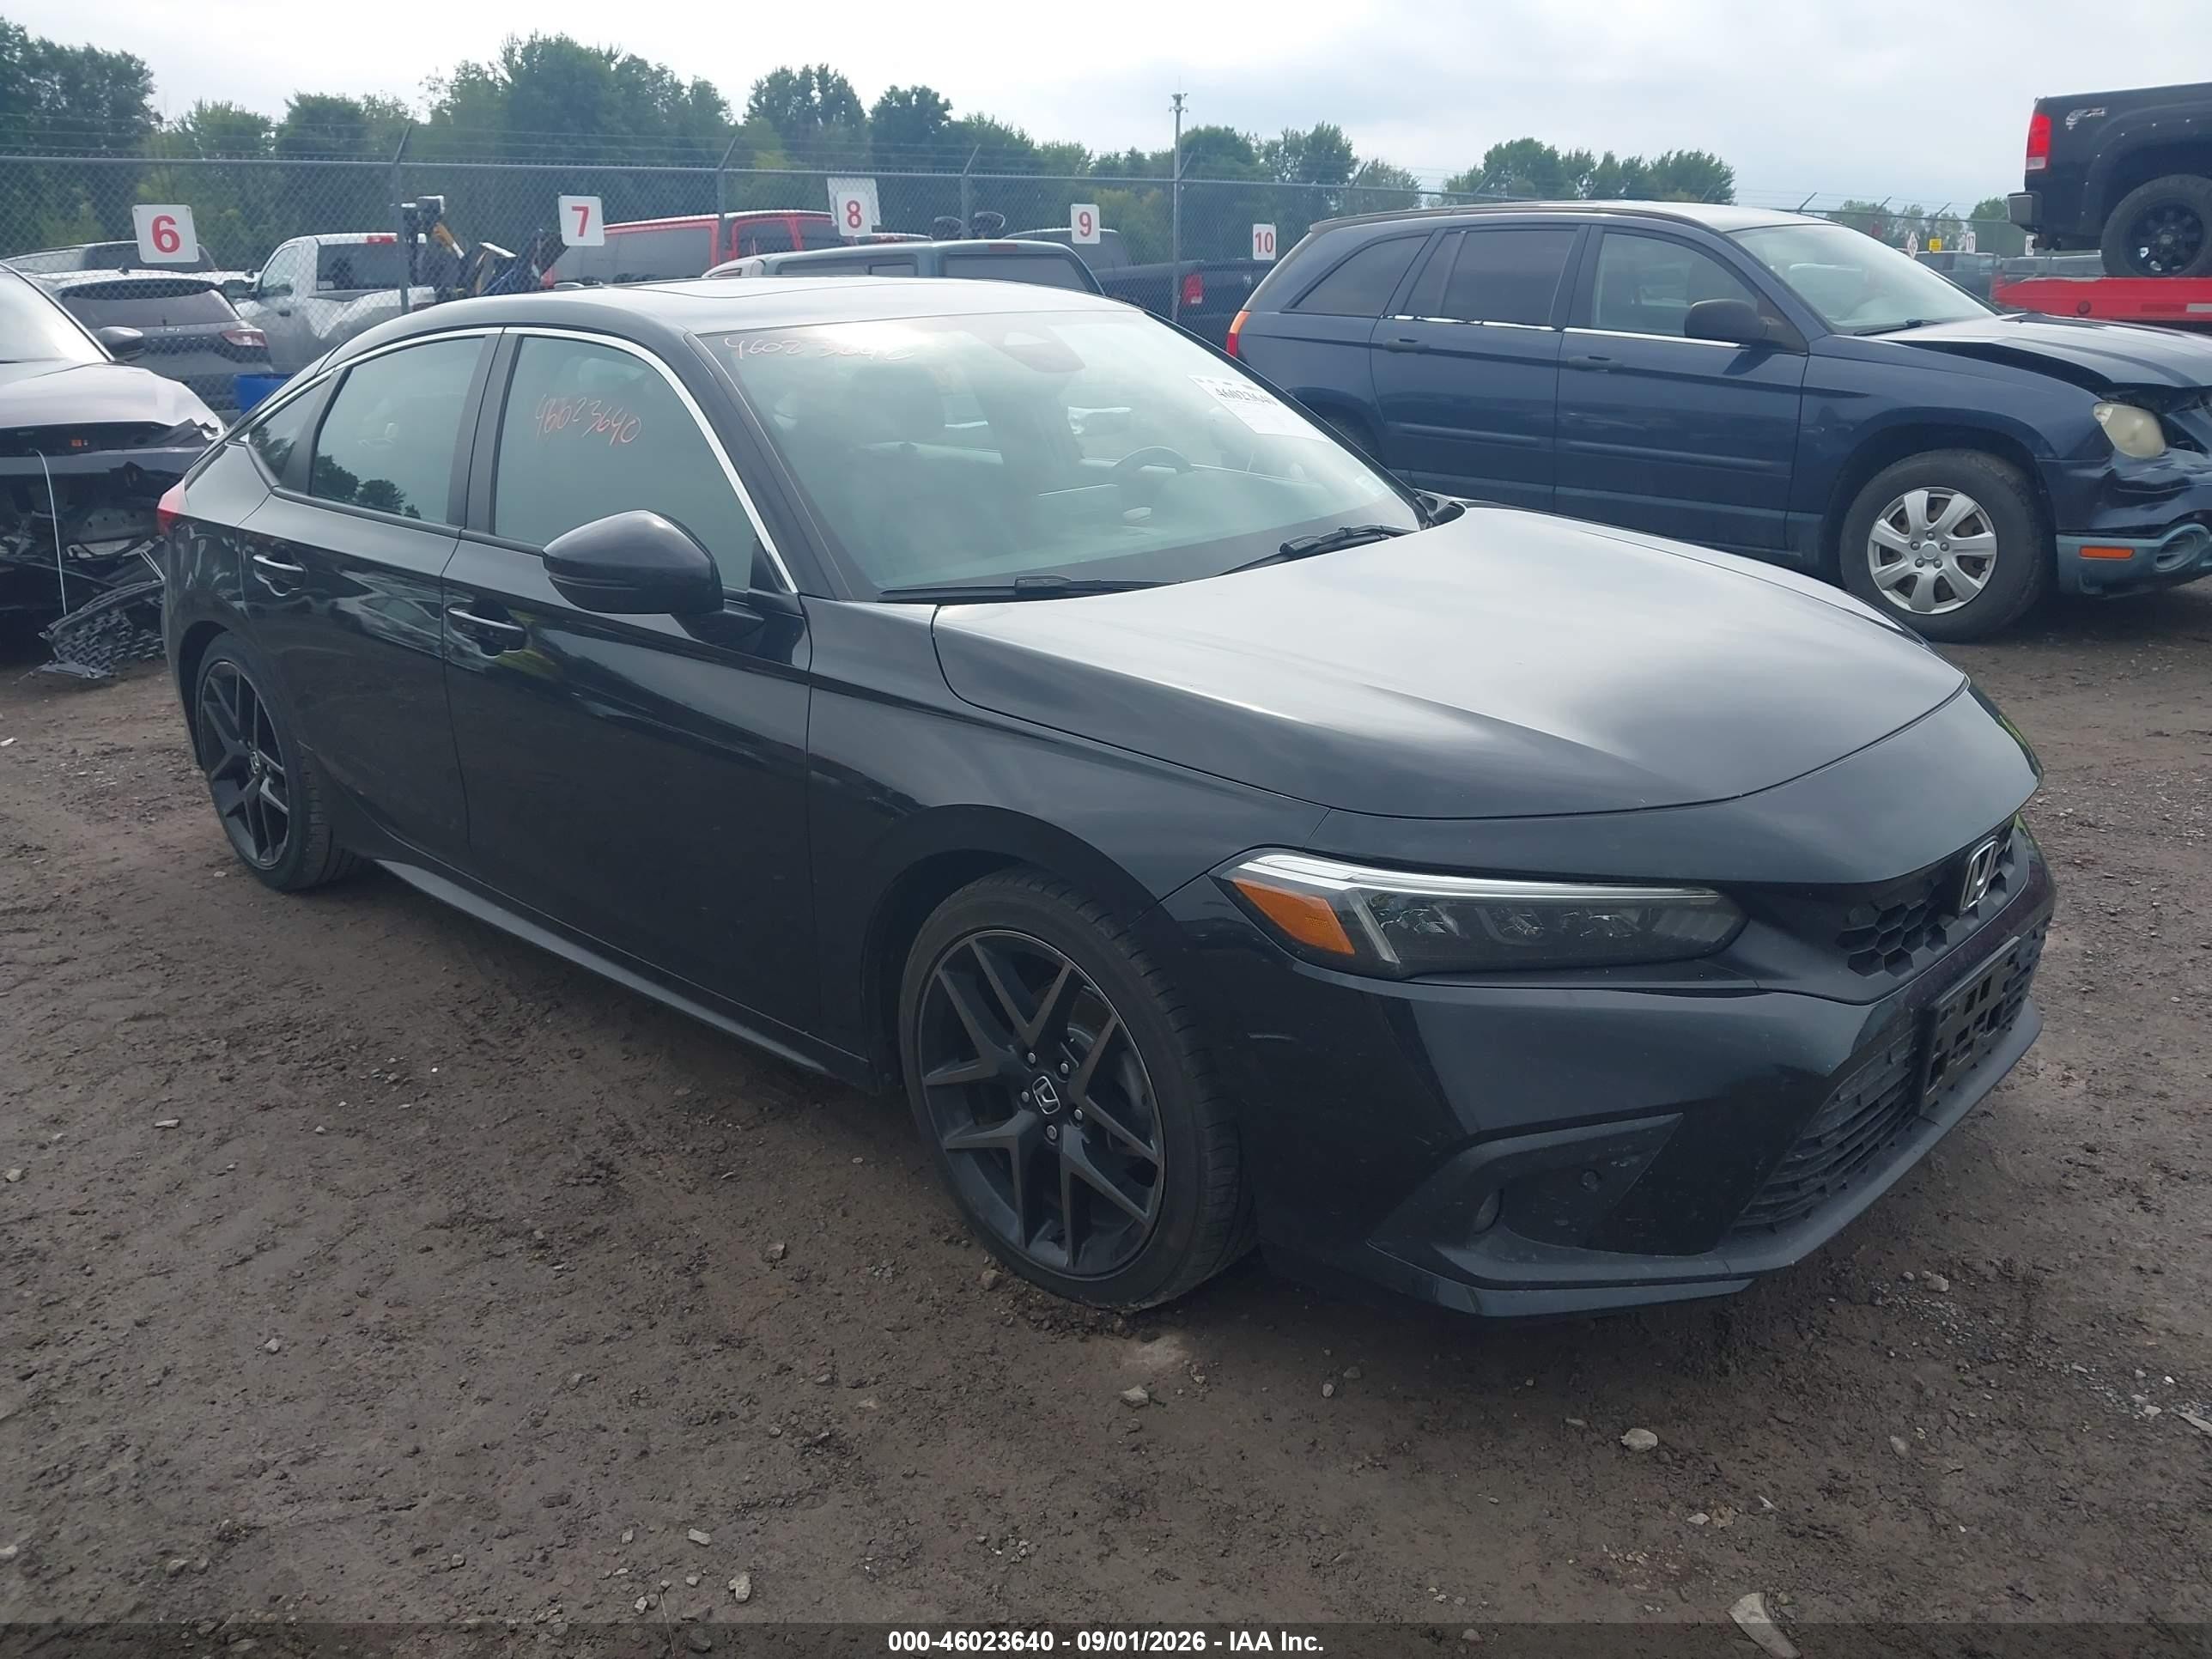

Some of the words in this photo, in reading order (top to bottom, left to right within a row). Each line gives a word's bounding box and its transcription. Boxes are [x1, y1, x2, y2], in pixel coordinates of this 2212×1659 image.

[571, 205, 589, 237] 7
[846, 200, 862, 228] 8
[1079, 211, 1092, 237] 9
[152, 215, 180, 252] 6
[1255, 232, 1273, 253] 10
